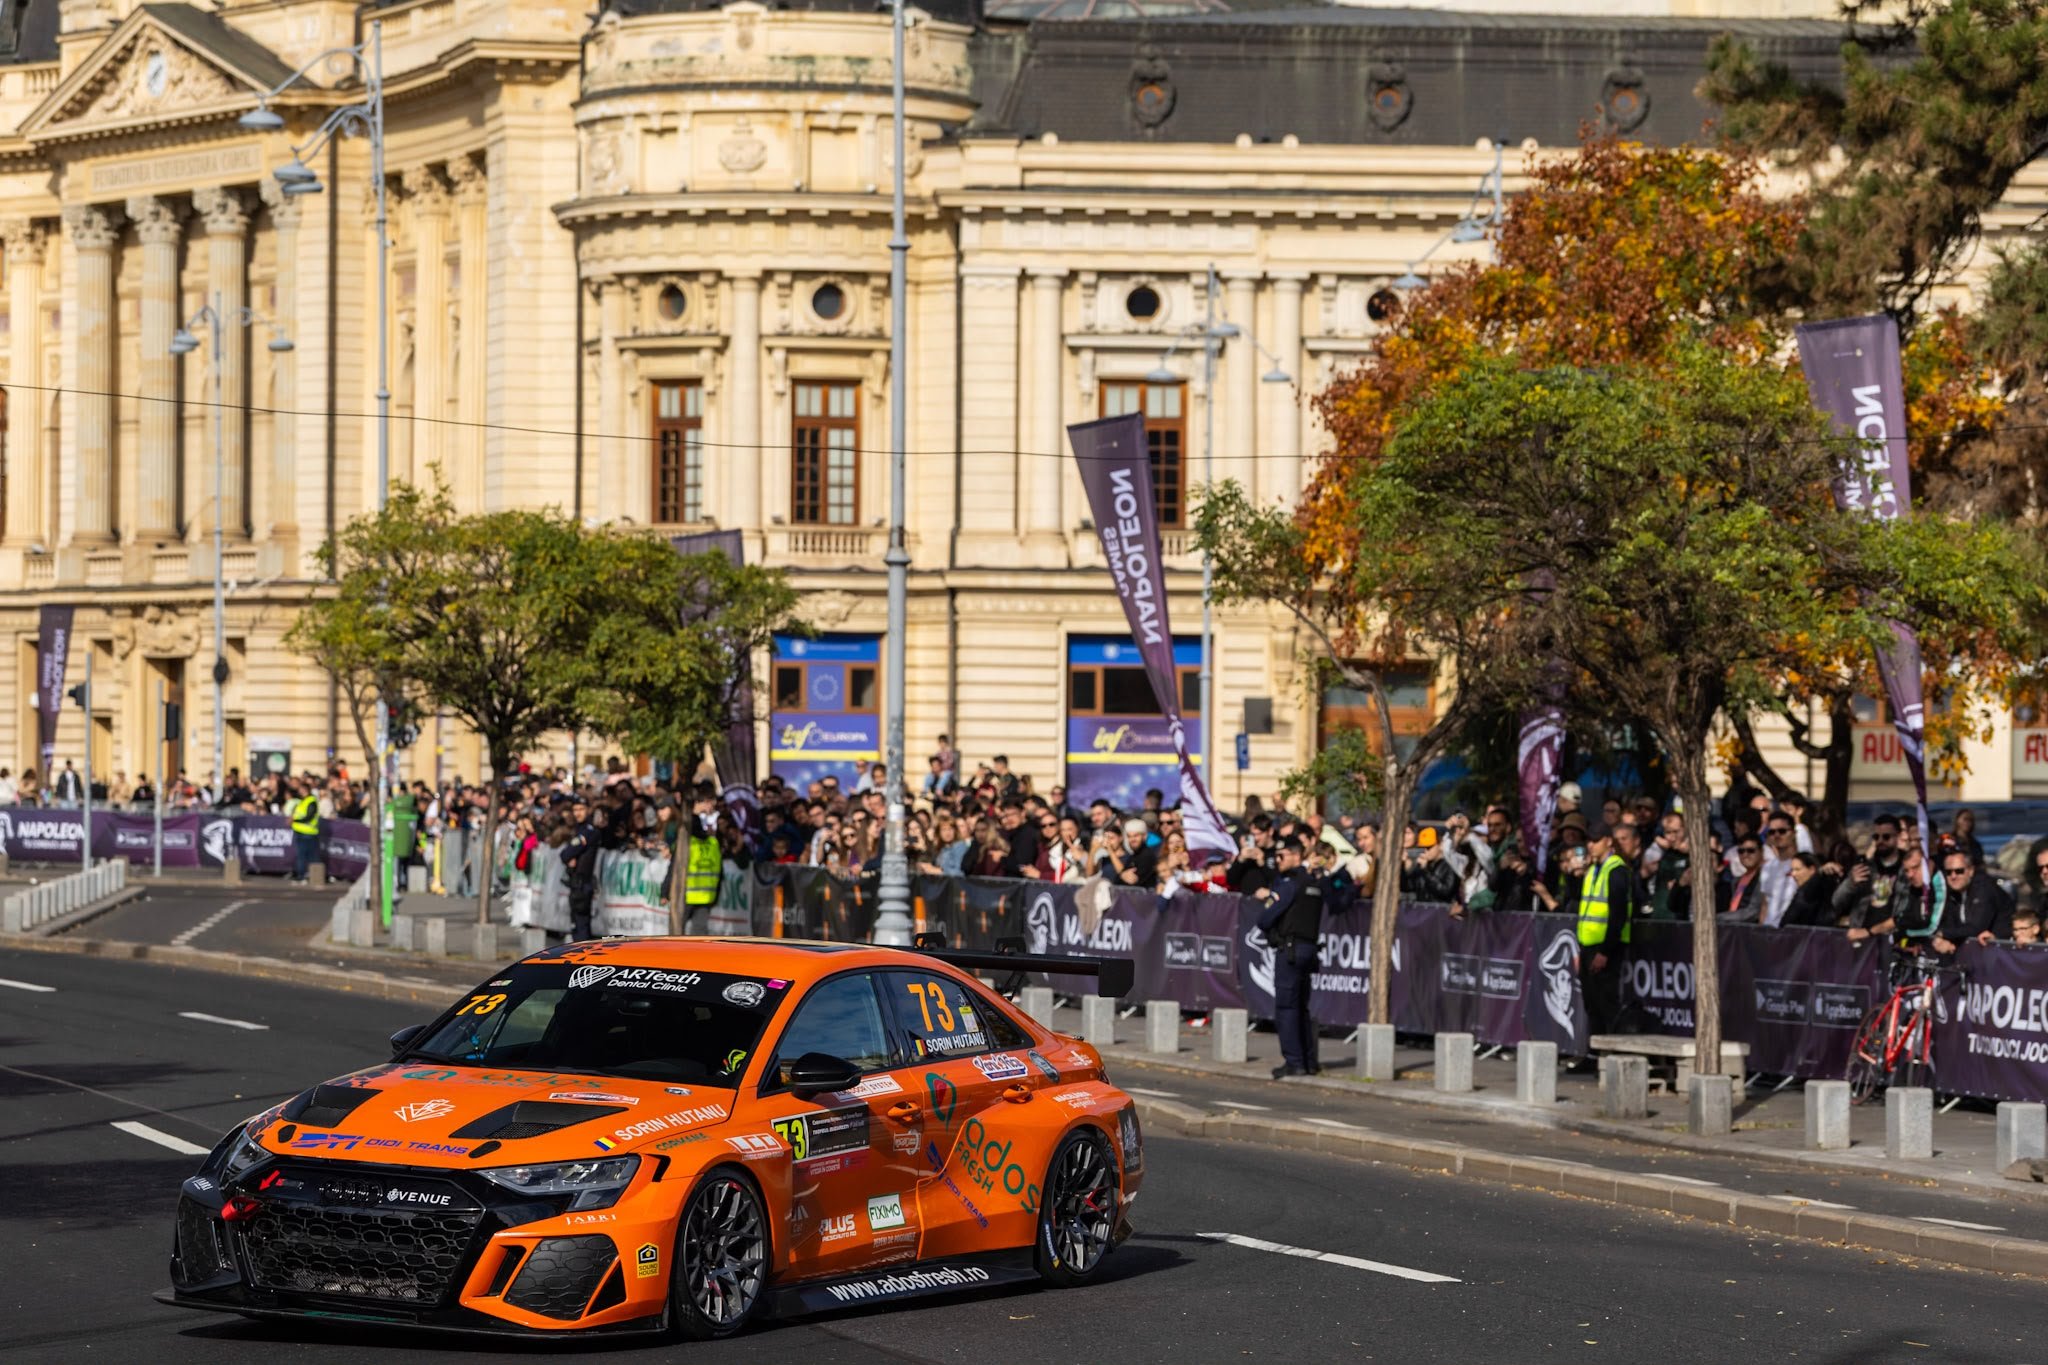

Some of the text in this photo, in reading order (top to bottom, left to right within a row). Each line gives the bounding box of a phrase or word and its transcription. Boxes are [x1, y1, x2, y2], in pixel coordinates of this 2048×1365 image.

[606, 978, 689, 993] Dental Clinic
[618, 968, 702, 986] ARTeeth
[455, 993, 508, 1016] 73
[906, 981, 956, 1033] 73
[925, 1032, 986, 1053] SORIN HUTANU
[870, 1080, 895, 1091] SYSTEM
[614, 1103, 728, 1142] SORIN HUTANU
[364, 1137, 402, 1148] DIDI
[408, 1141, 469, 1154] TRANS
[774, 1119, 806, 1161] 73
[955, 1140, 994, 1195] FRESH
[965, 1117, 1041, 1215] ados
[398, 1191, 451, 1206] VENUE
[565, 1213, 617, 1226] JABRI
[869, 1202, 901, 1221] FIXIMO
[963, 1195, 990, 1229] TRANS
[638, 1263, 659, 1272] SOUND
[638, 1268, 659, 1277] HOUSE
[826, 1265, 990, 1302] www.adosfresh.ro
